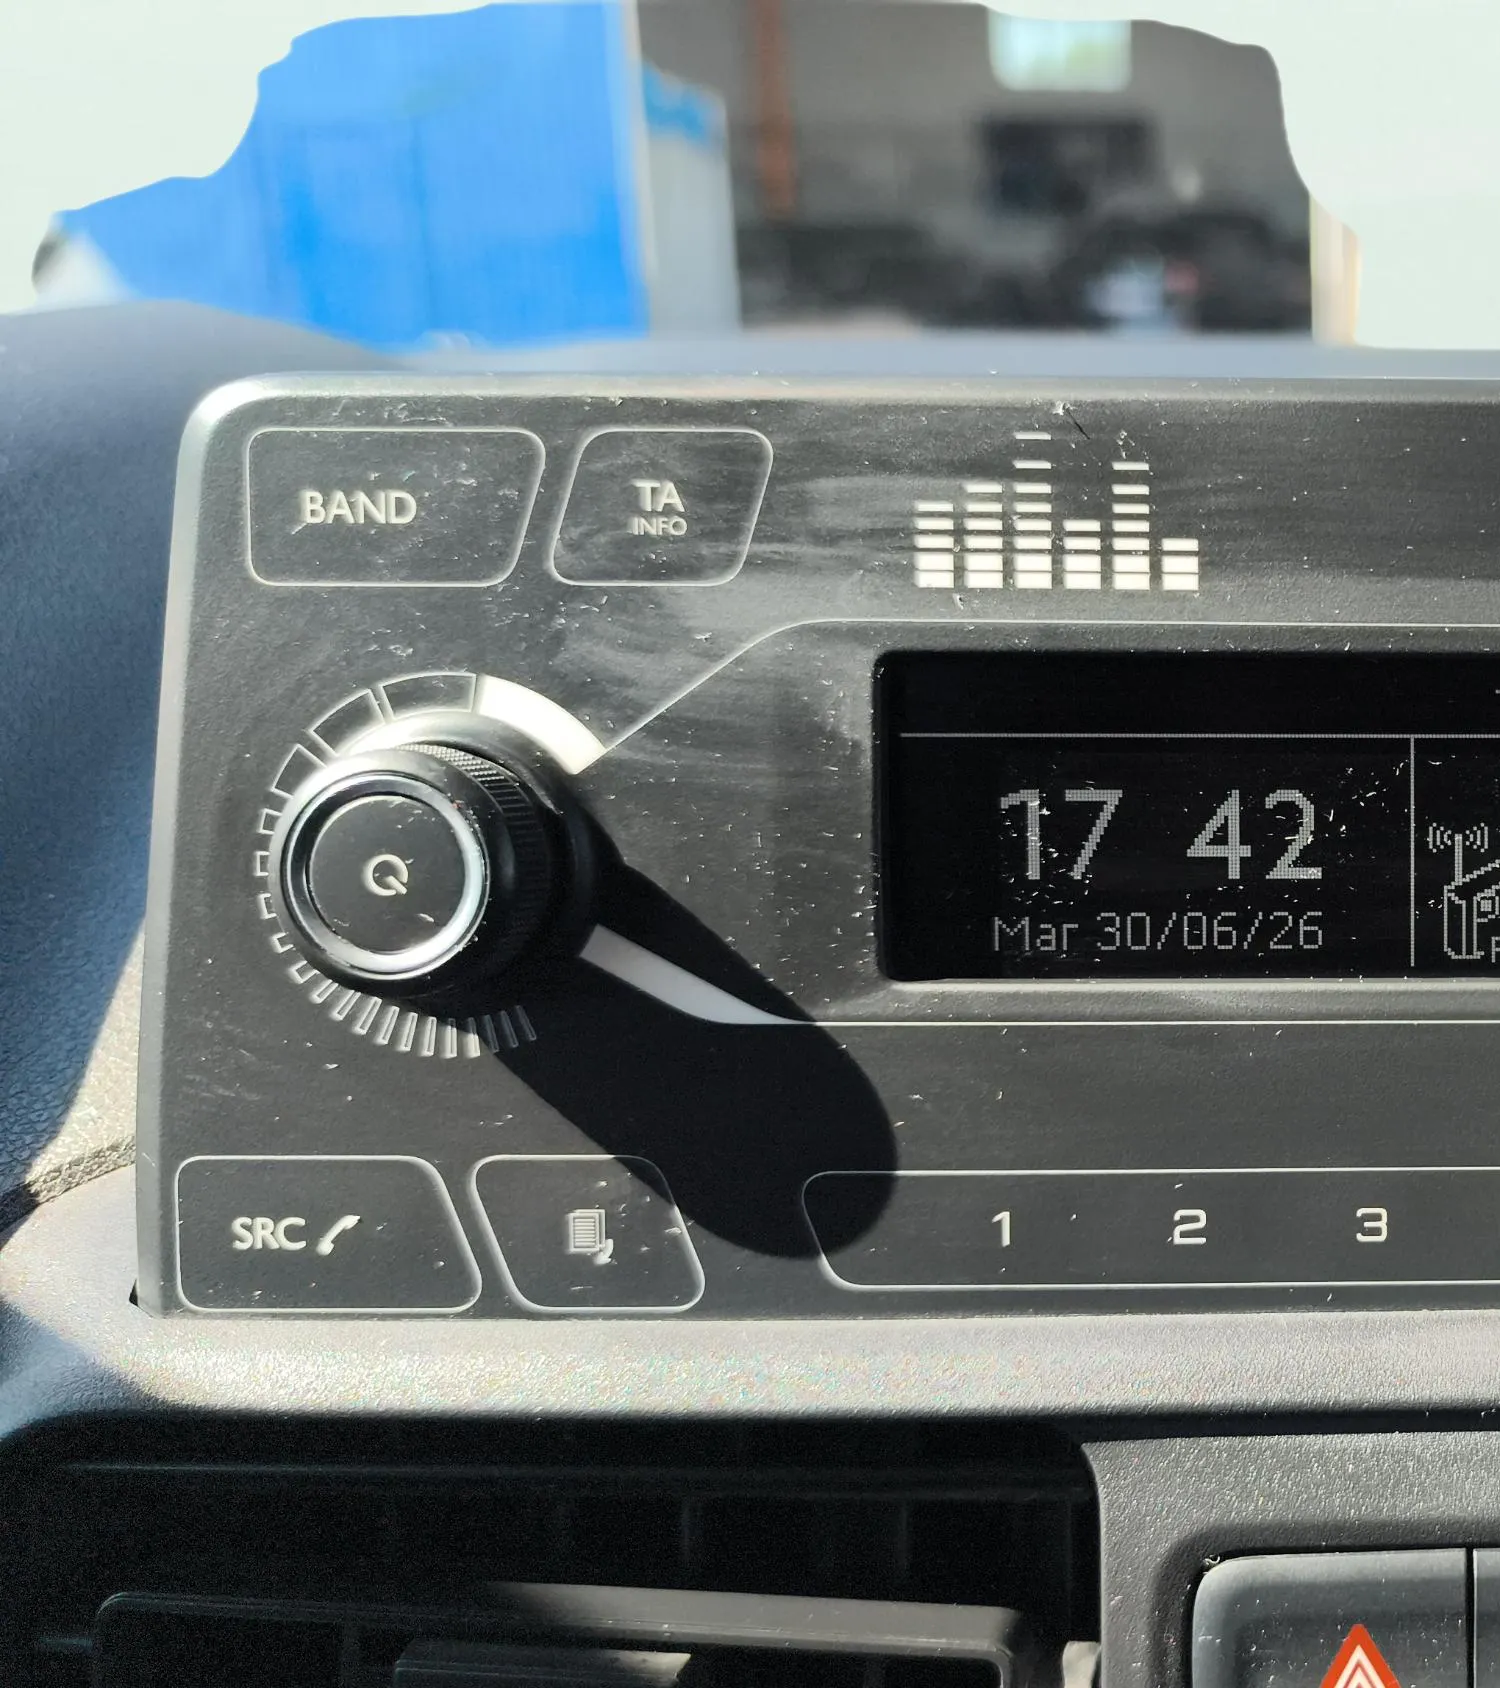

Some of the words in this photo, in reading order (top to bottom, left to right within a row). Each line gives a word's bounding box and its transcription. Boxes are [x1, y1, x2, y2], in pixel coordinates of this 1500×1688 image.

[301, 490, 417, 525] BAND
[634, 481, 685, 512] TA
[632, 516, 688, 536] INFO
[1000, 789, 1123, 880] 17
[1186, 789, 1323, 880] 42
[994, 916, 1079, 951] Mar
[1096, 912, 1323, 950] 30/06/26
[232, 1217, 306, 1252] SRC
[992, 1211, 1011, 1245] 1
[1173, 1209, 1208, 1245] 2
[1356, 1207, 1388, 1242] 3
